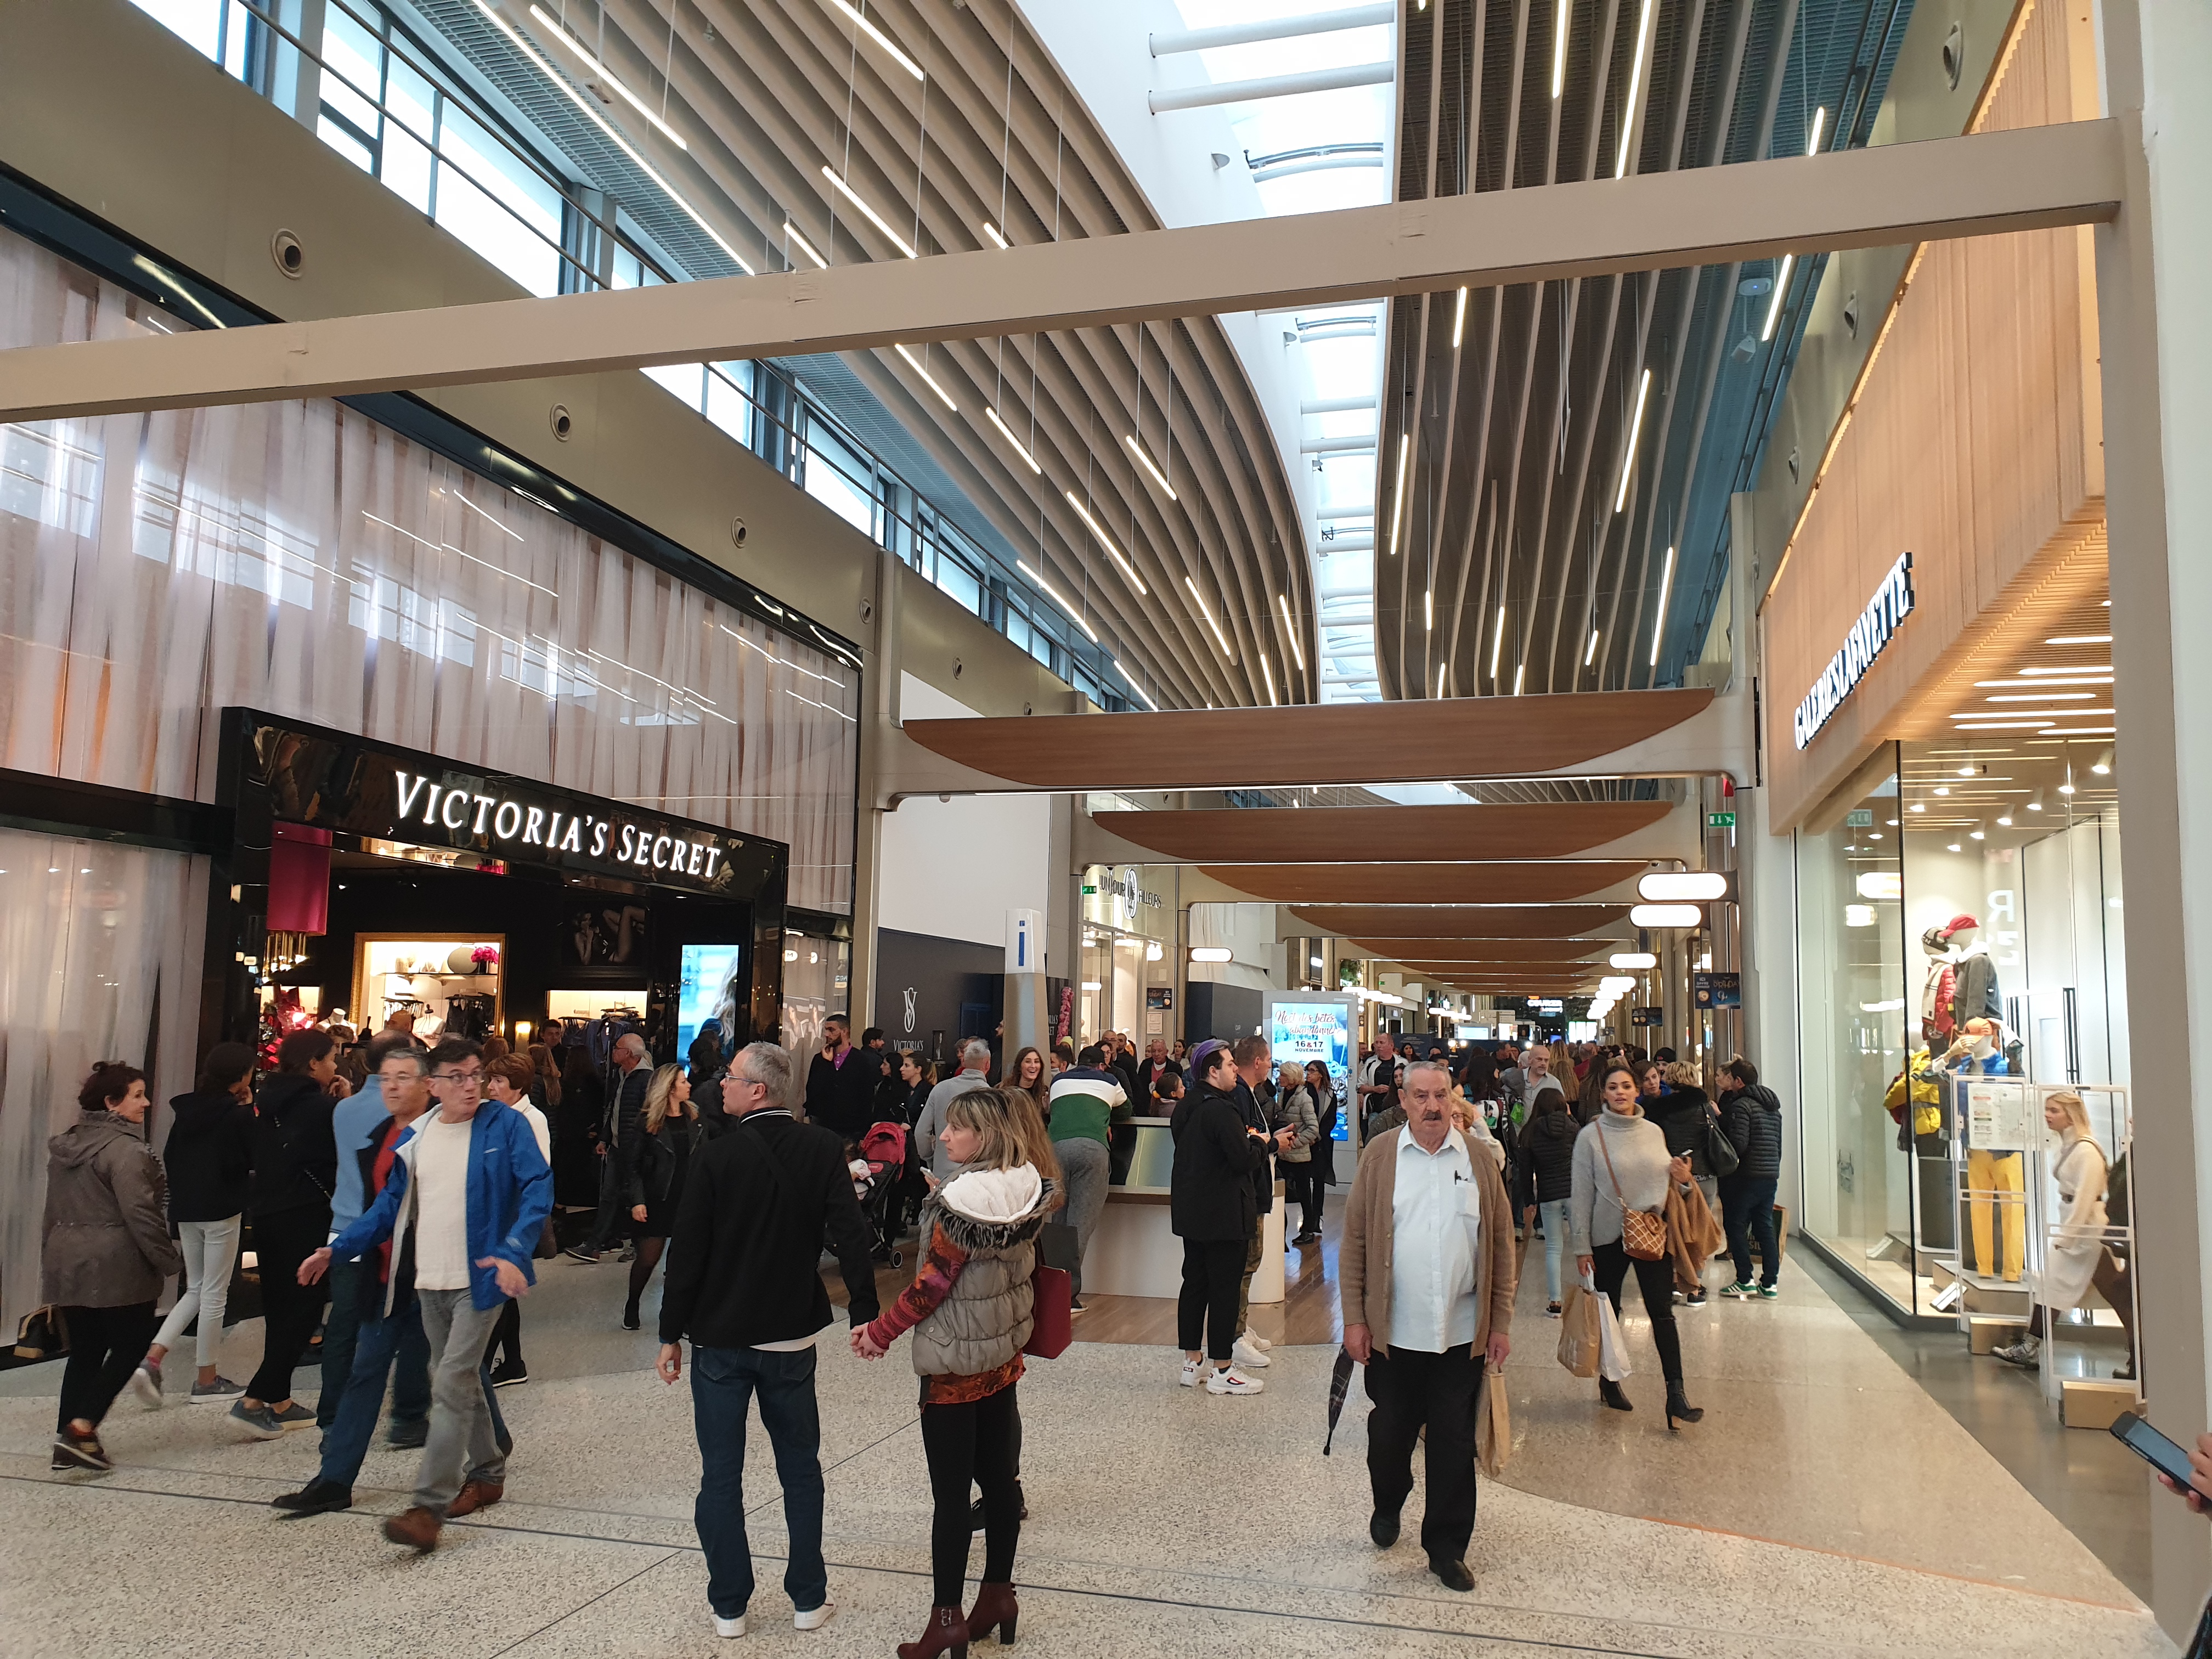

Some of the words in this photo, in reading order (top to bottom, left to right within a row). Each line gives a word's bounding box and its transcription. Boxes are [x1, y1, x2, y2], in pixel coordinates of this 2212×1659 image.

[395, 771, 607, 857] VICTORIA'S
[617, 824, 720, 878] SECRET
[1138, 889, 1161, 909] AILLEURS
[1299, 1013, 1313, 1023] des
[1316, 1013, 1335, 1023] bêtes
[893, 1040, 923, 1052] VICTORIA'S
